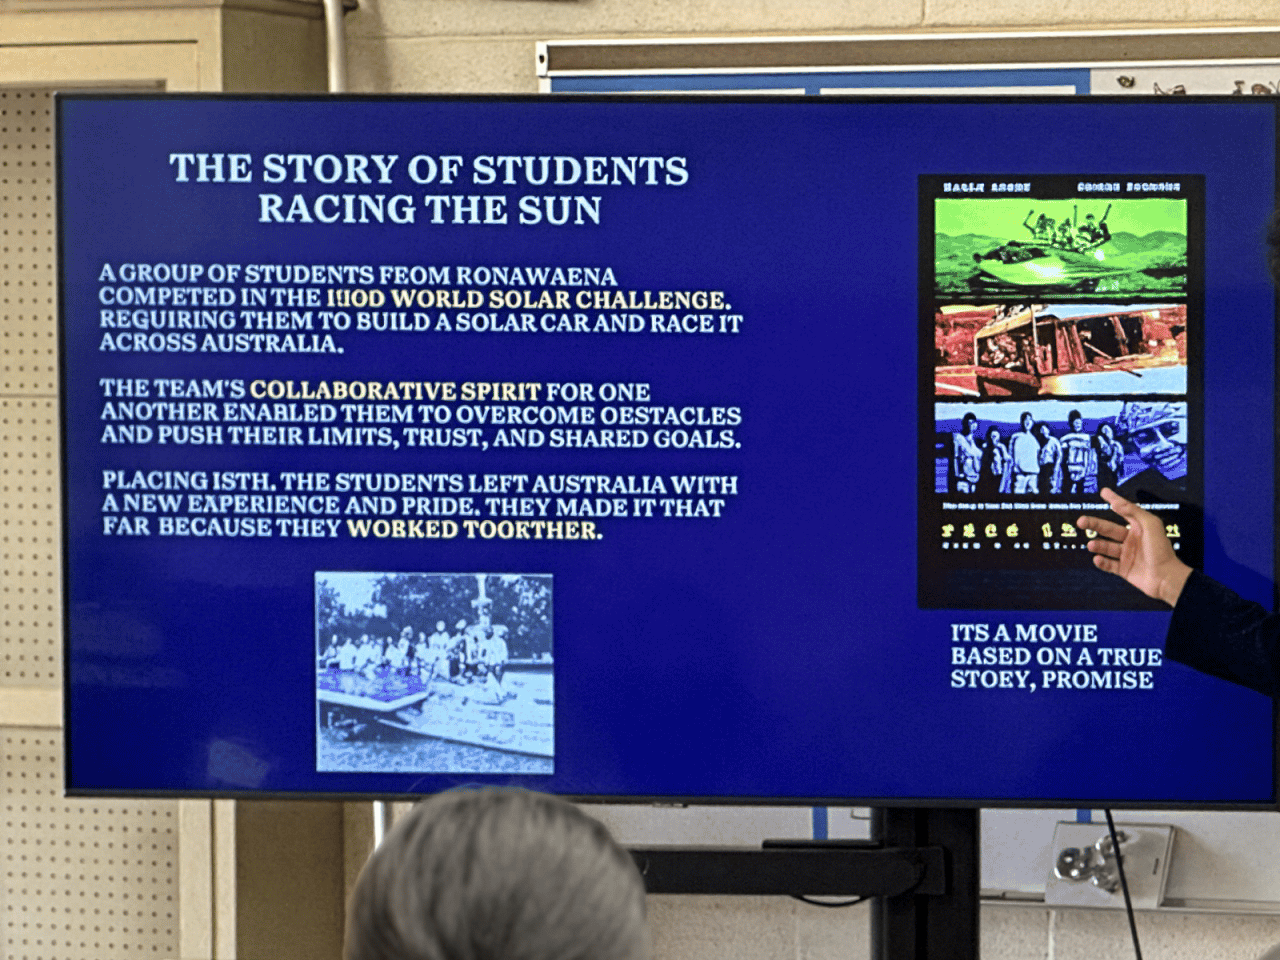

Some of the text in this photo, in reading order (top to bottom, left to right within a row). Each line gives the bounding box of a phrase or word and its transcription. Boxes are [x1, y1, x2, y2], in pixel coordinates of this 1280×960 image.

[168, 153, 689, 186] THE STORY OF STUDENTS
[258, 193, 602, 226] RACING THE SUN
[98, 263, 117, 282] A
[118, 262, 205, 283] GROUP
[207, 263, 242, 284] OF
[244, 263, 375, 285] STUDENTS
[98, 286, 237, 307] COMPETED
[240, 287, 267, 307] IN
[270, 287, 322, 307] THE
[390, 288, 485, 309] WORLD
[488, 289, 572, 310] SOLAR
[575, 290, 732, 311] CHALLENGE.
[239, 310, 314, 331] THEM
[317, 311, 352, 331] TO
[356, 311, 431, 332] BUILD
[434, 312, 453, 332] A
[455, 312, 538, 333] SOLAR
[540, 313, 591, 333] CAR
[592, 313, 646, 333] AND
[650, 314, 715, 334] RACE
[718, 314, 744, 333] IT
[99, 332, 345, 354] ACROSS AUSTRALIA.
[99, 378, 651, 402] THE TEAM'S COLLABORATIVE SPIRIT FOR ONE
[100, 401, 220, 422] ANOTHER
[340, 403, 414, 424] THEM
[417, 404, 452, 424] TO
[455, 404, 596, 425] OVERCOME
[101, 424, 742, 452] AND PUSH THEIR LIMITS, TRUST, AND SHARED GOALS.
[102, 470, 209, 491] PLACING
[279, 472, 330, 492] THE
[335, 472, 465, 493] STUDENTS
[468, 474, 529, 494] LEFT
[531, 474, 668, 495] AUSTRALIA
[670, 475, 738, 495] WITH
[102, 493, 120, 512] A
[123, 493, 183, 513] NEW
[344, 495, 397, 515] AND
[401, 496, 481, 517] PRIDE.
[484, 497, 552, 517] THEY
[555, 497, 629, 517] MADE
[632, 498, 657, 517] IT
[659, 498, 726, 518] THAT
[103, 516, 151, 536] FAR
[158, 516, 273, 537] BECAUSE
[275, 518, 342, 538] THEY
[950, 623, 1098, 643] ITS A MOVIE
[951, 646, 1163, 667] BASED ON A TRUE
[1041, 670, 1154, 690] PROMISE
